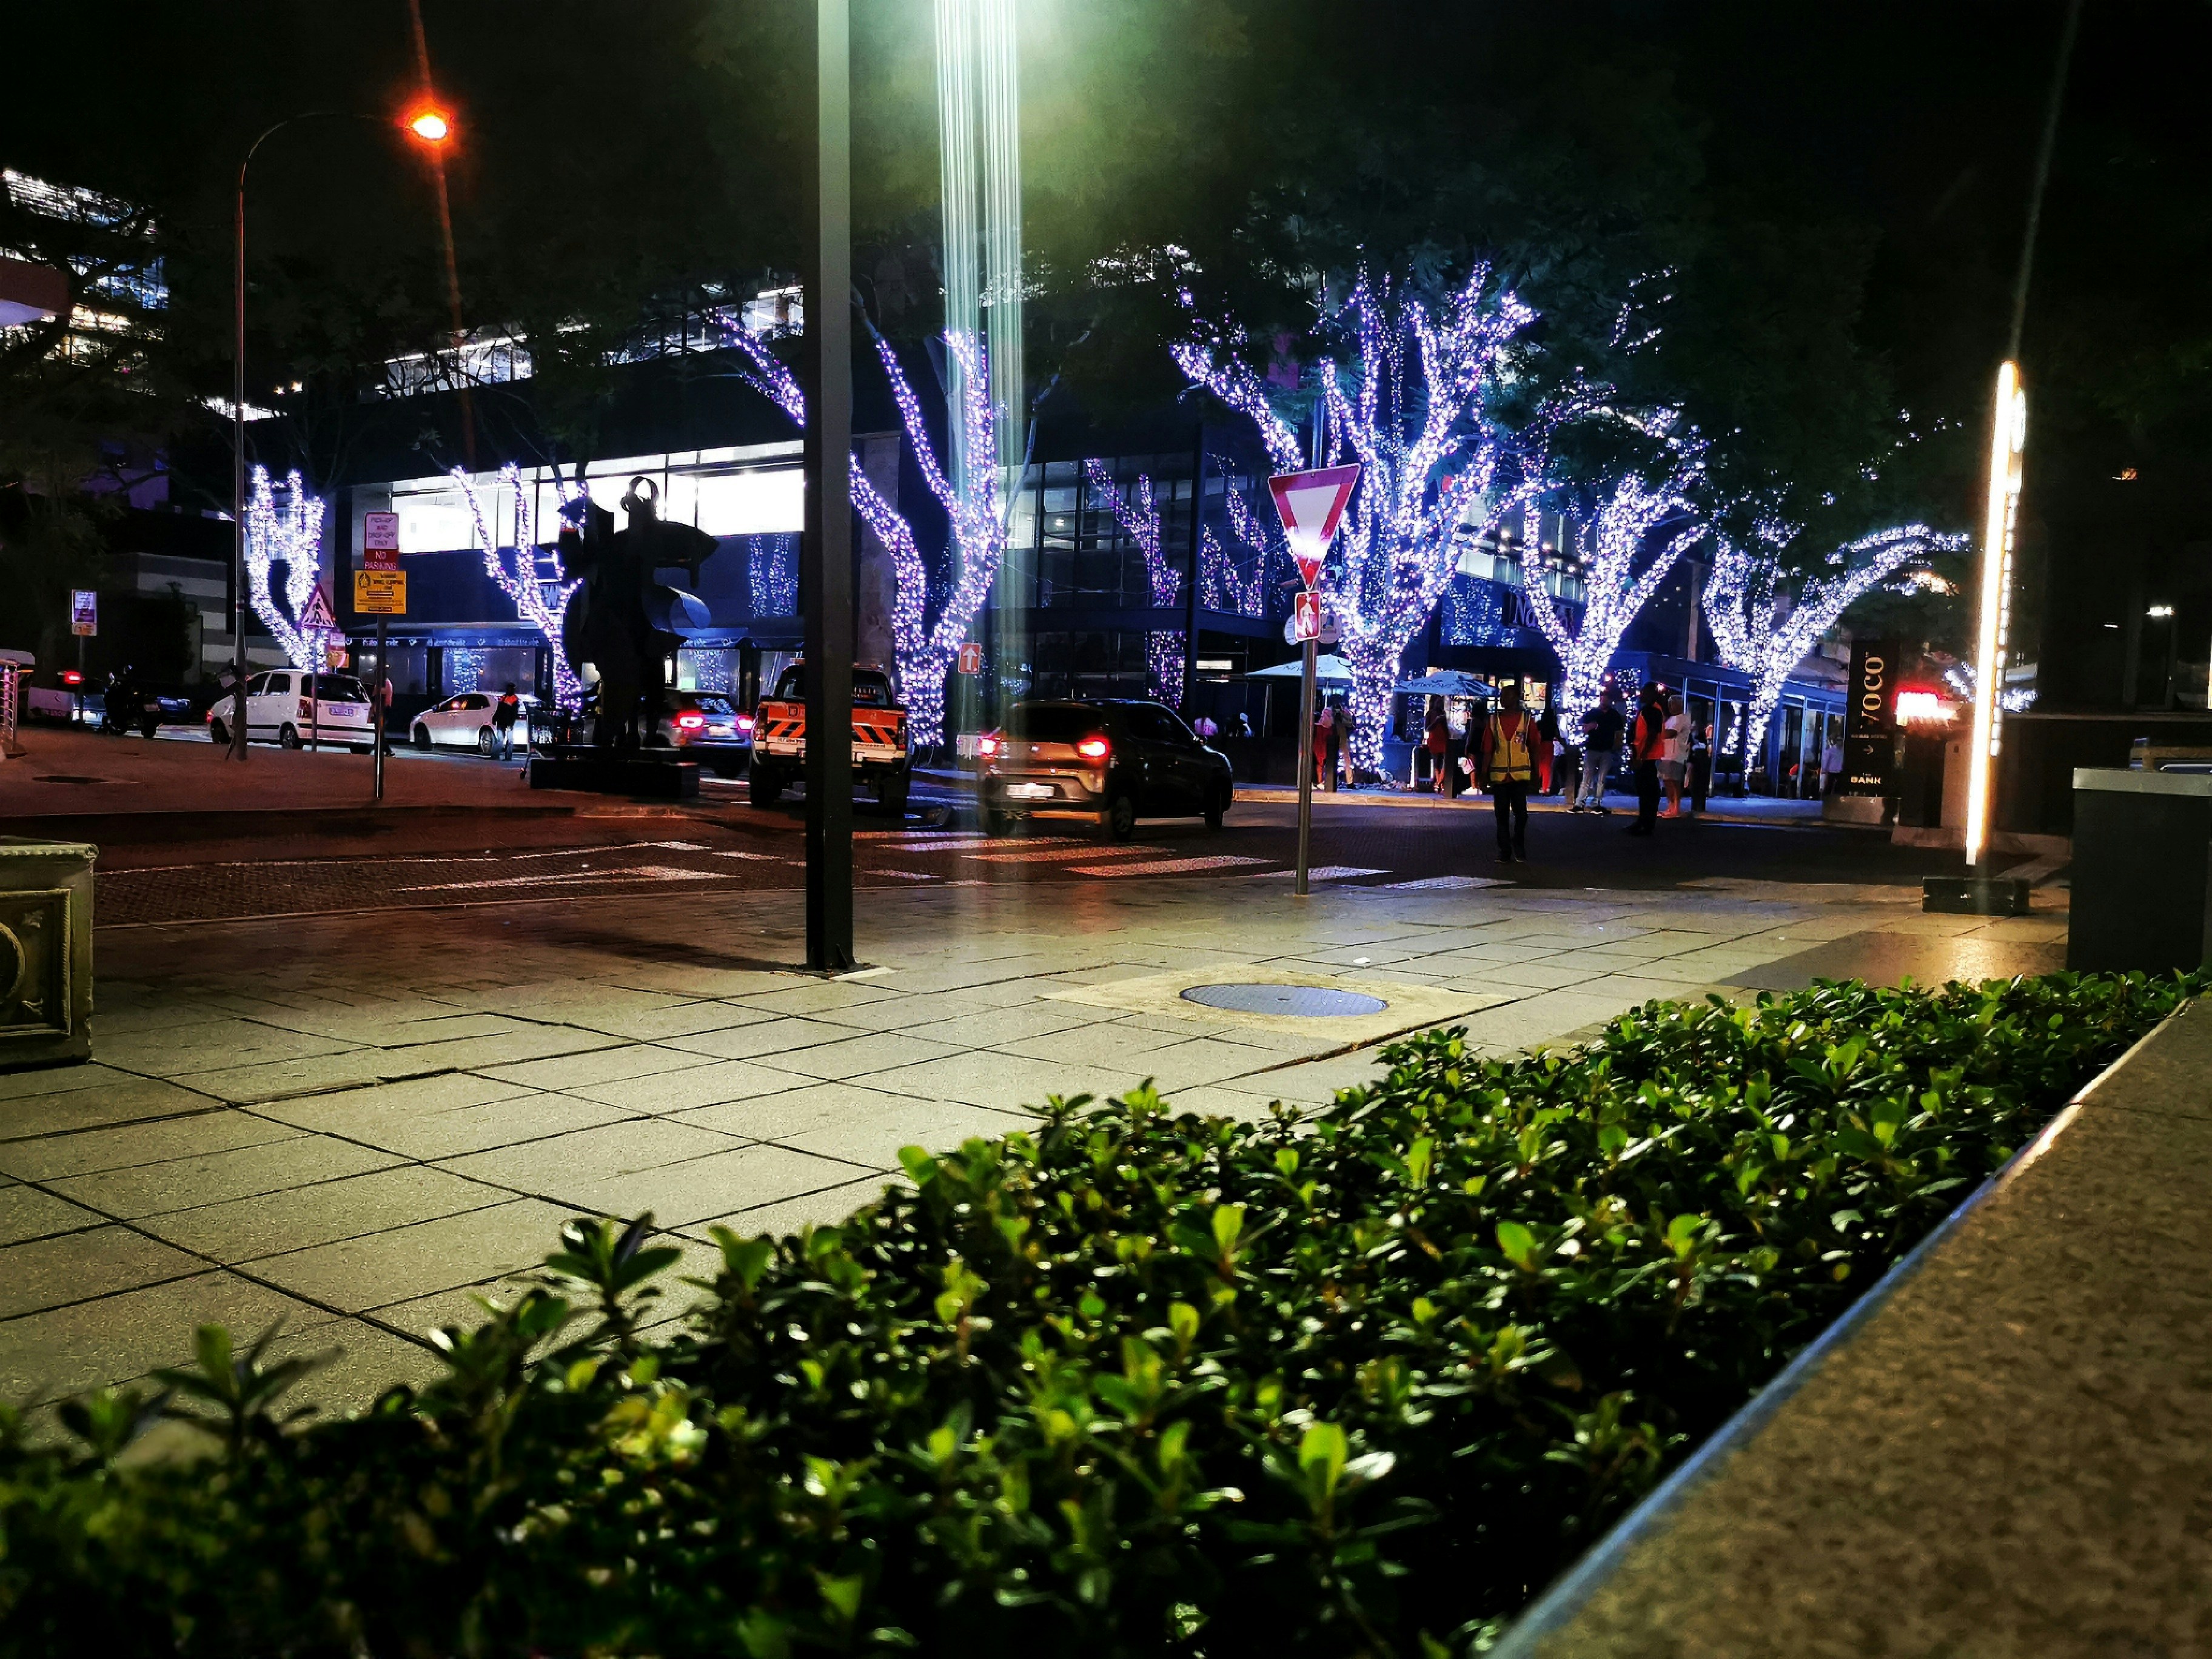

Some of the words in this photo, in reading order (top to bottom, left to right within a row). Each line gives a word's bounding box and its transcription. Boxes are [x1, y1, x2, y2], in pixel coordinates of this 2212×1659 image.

[375, 551, 387, 560] NO
[364, 561, 397, 570] PARKING
[1851, 776, 1882, 785] BANK
